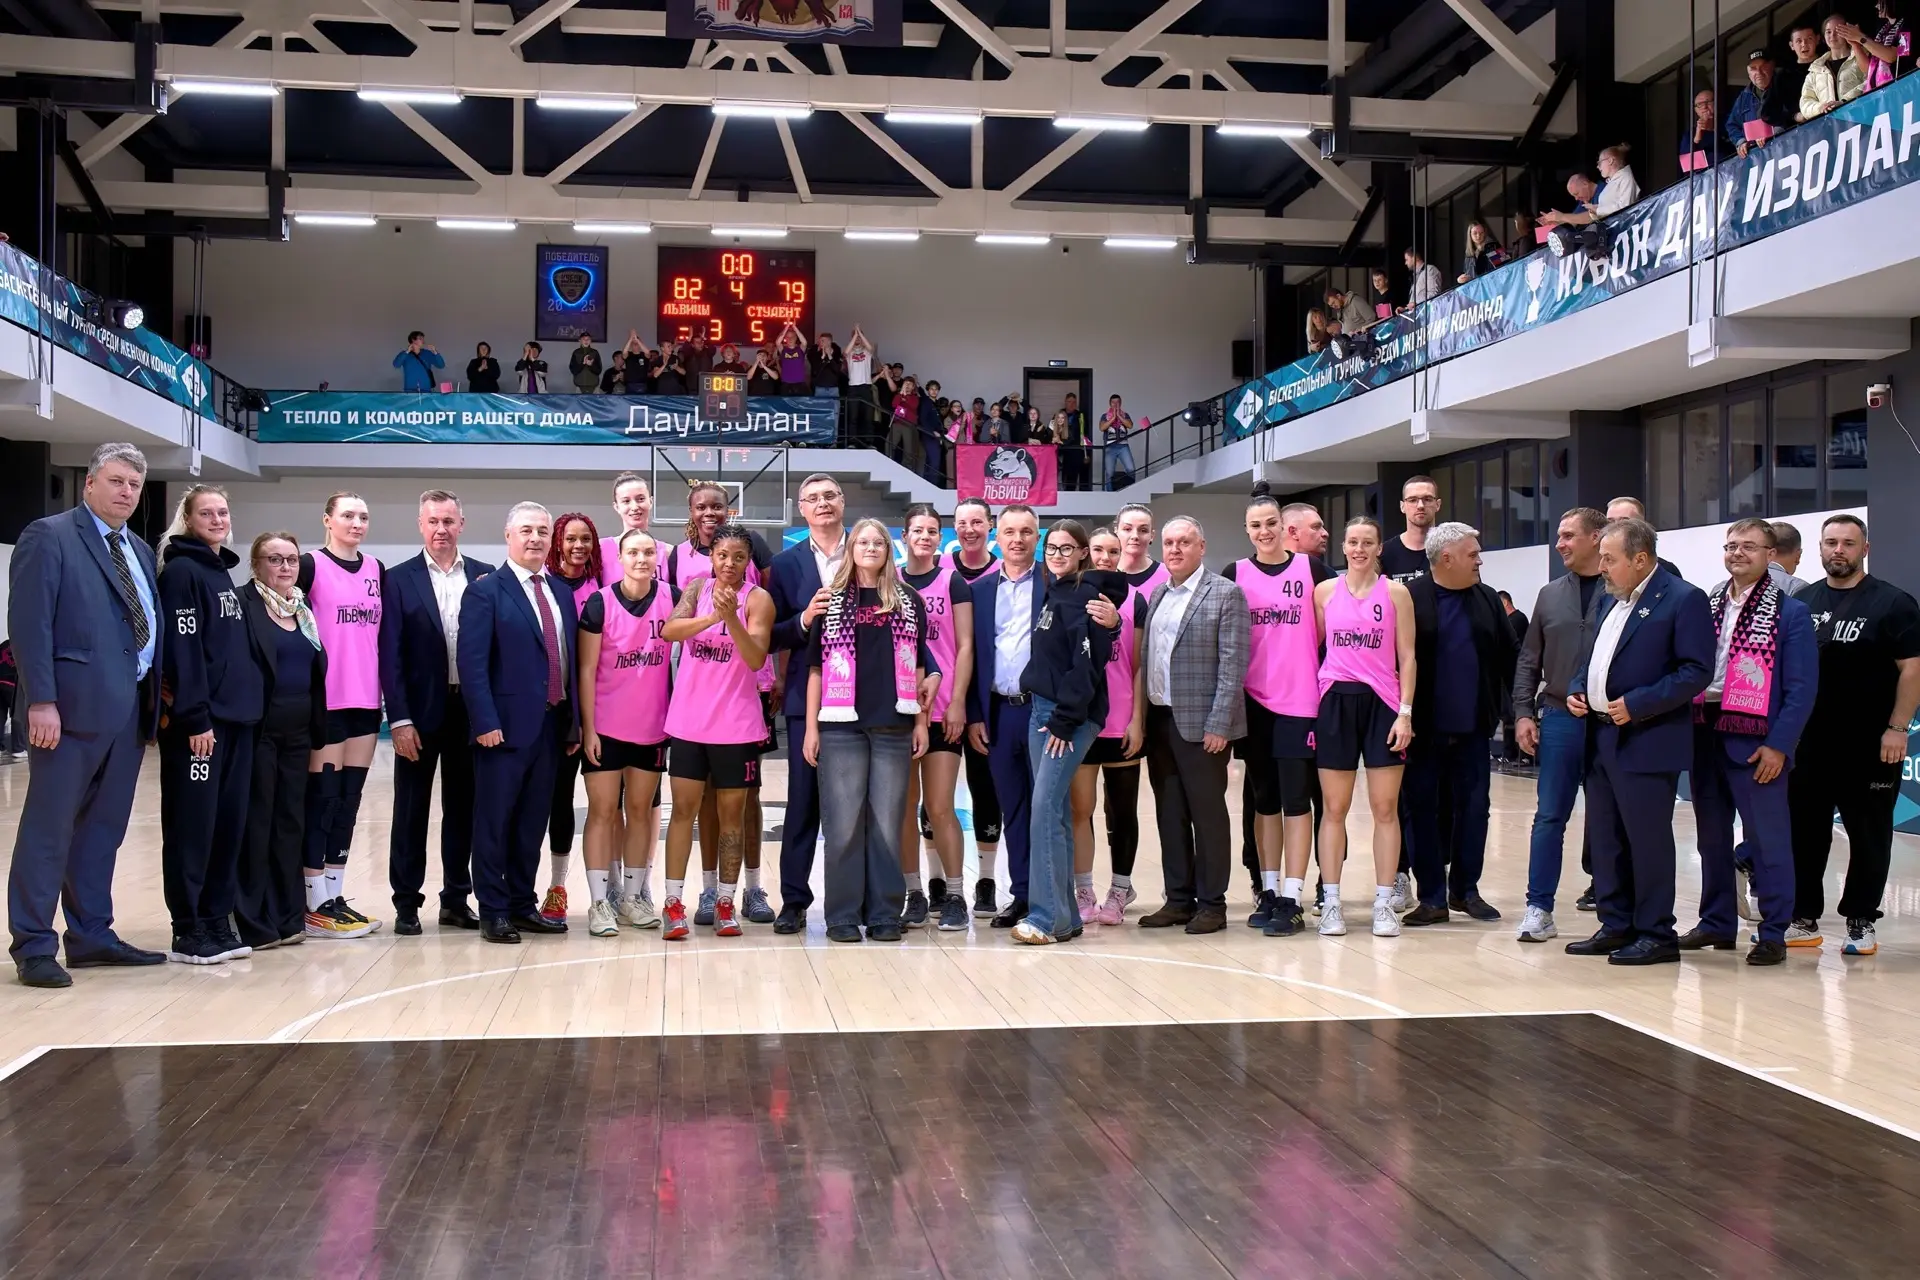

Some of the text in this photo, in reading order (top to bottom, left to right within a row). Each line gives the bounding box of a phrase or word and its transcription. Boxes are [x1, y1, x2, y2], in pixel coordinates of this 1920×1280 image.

[1557, 218, 1652, 303] КУБОК
[1654, 180, 1733, 268] ДАУ
[546, 251, 600, 263] ПОБЕДИТЕЛЬ
[722, 253, 752, 275] 0:0
[675, 278, 702, 299] 82
[730, 281, 743, 300] 4
[778, 281, 805, 302] 79
[581, 299, 596, 312] 25
[663, 303, 711, 316] ЛЬВИЦЫ
[747, 305, 801, 318] СТУДЕНТ
[1450, 294, 1504, 334] КОМАНД
[282, 410, 594, 427] ТЕПЛО И КОМФОРТ ВАШЕГО ДОМА
[364, 579, 380, 598] 23
[1282, 580, 1304, 599] 40
[925, 596, 945, 615] 33
[1373, 604, 1383, 622] 9
[177, 616, 197, 635] 69
[190, 762, 210, 781] 69
